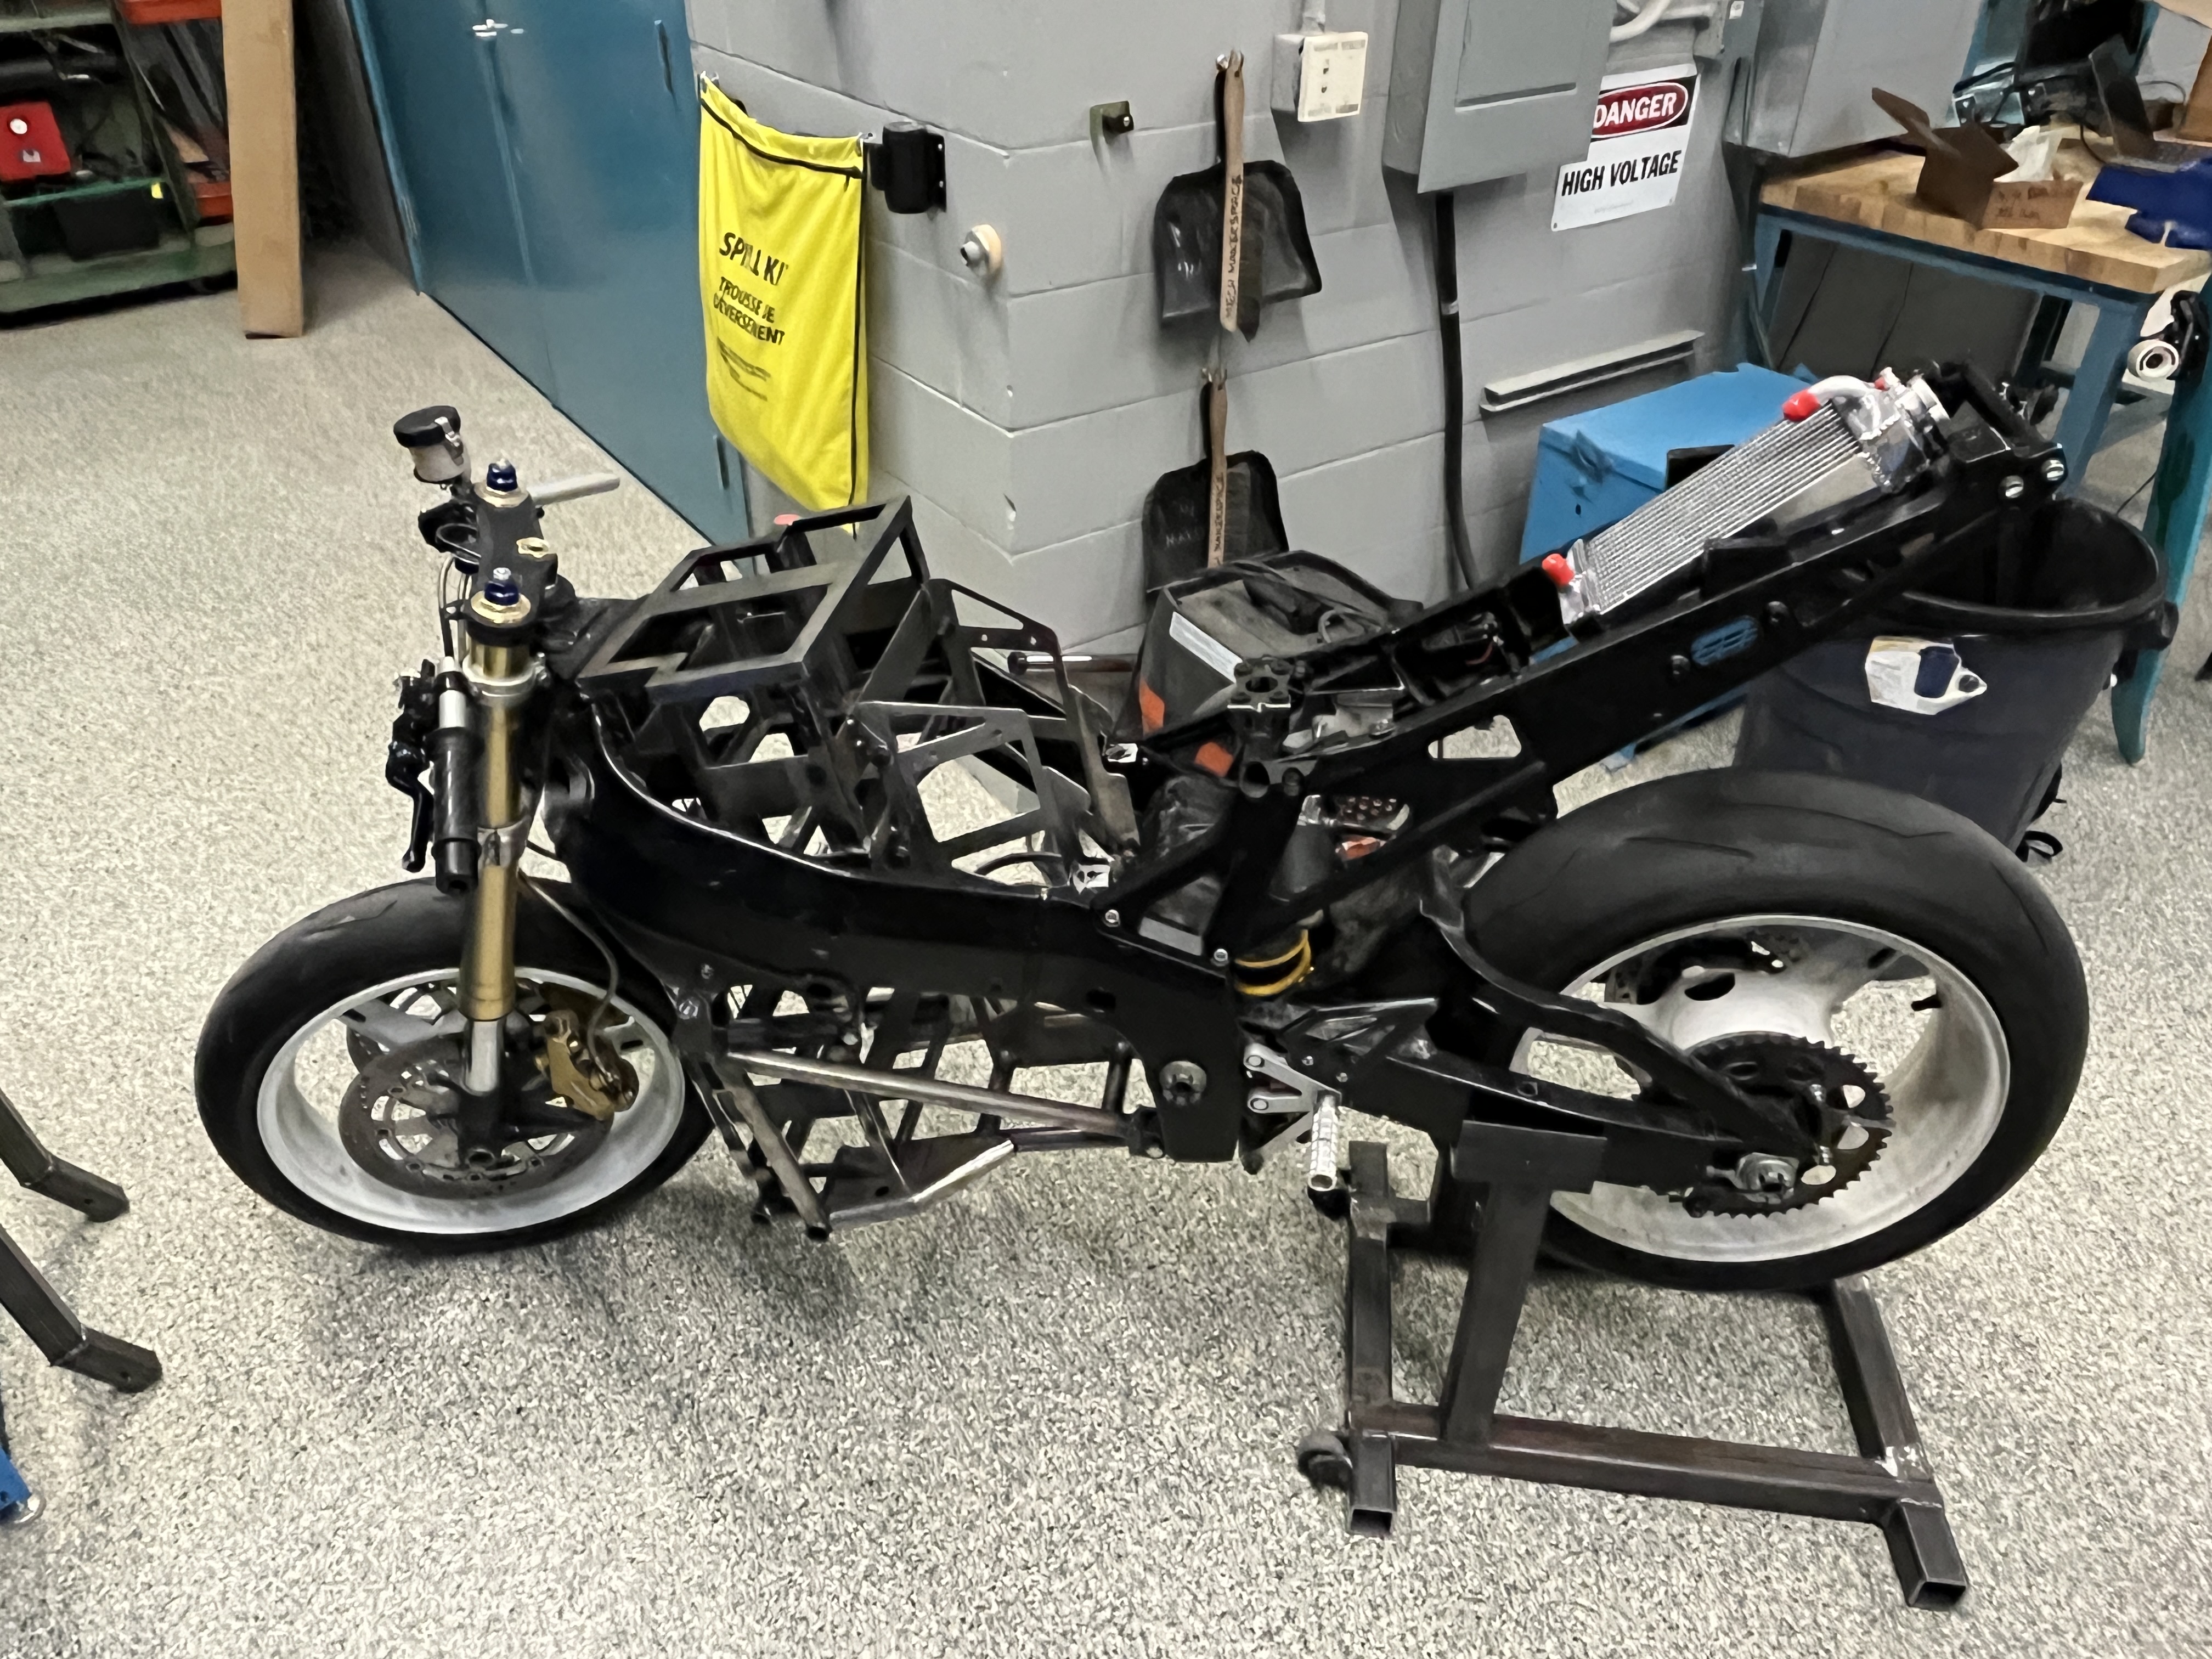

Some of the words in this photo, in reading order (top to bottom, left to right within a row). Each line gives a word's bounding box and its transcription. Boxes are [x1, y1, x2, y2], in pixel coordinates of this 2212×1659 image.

[1593, 92, 1677, 129] DANGER
[1561, 165, 1605, 196] HIGH
[1610, 150, 1682, 187] VOLTAGE
[763, 255, 789, 286] KI
